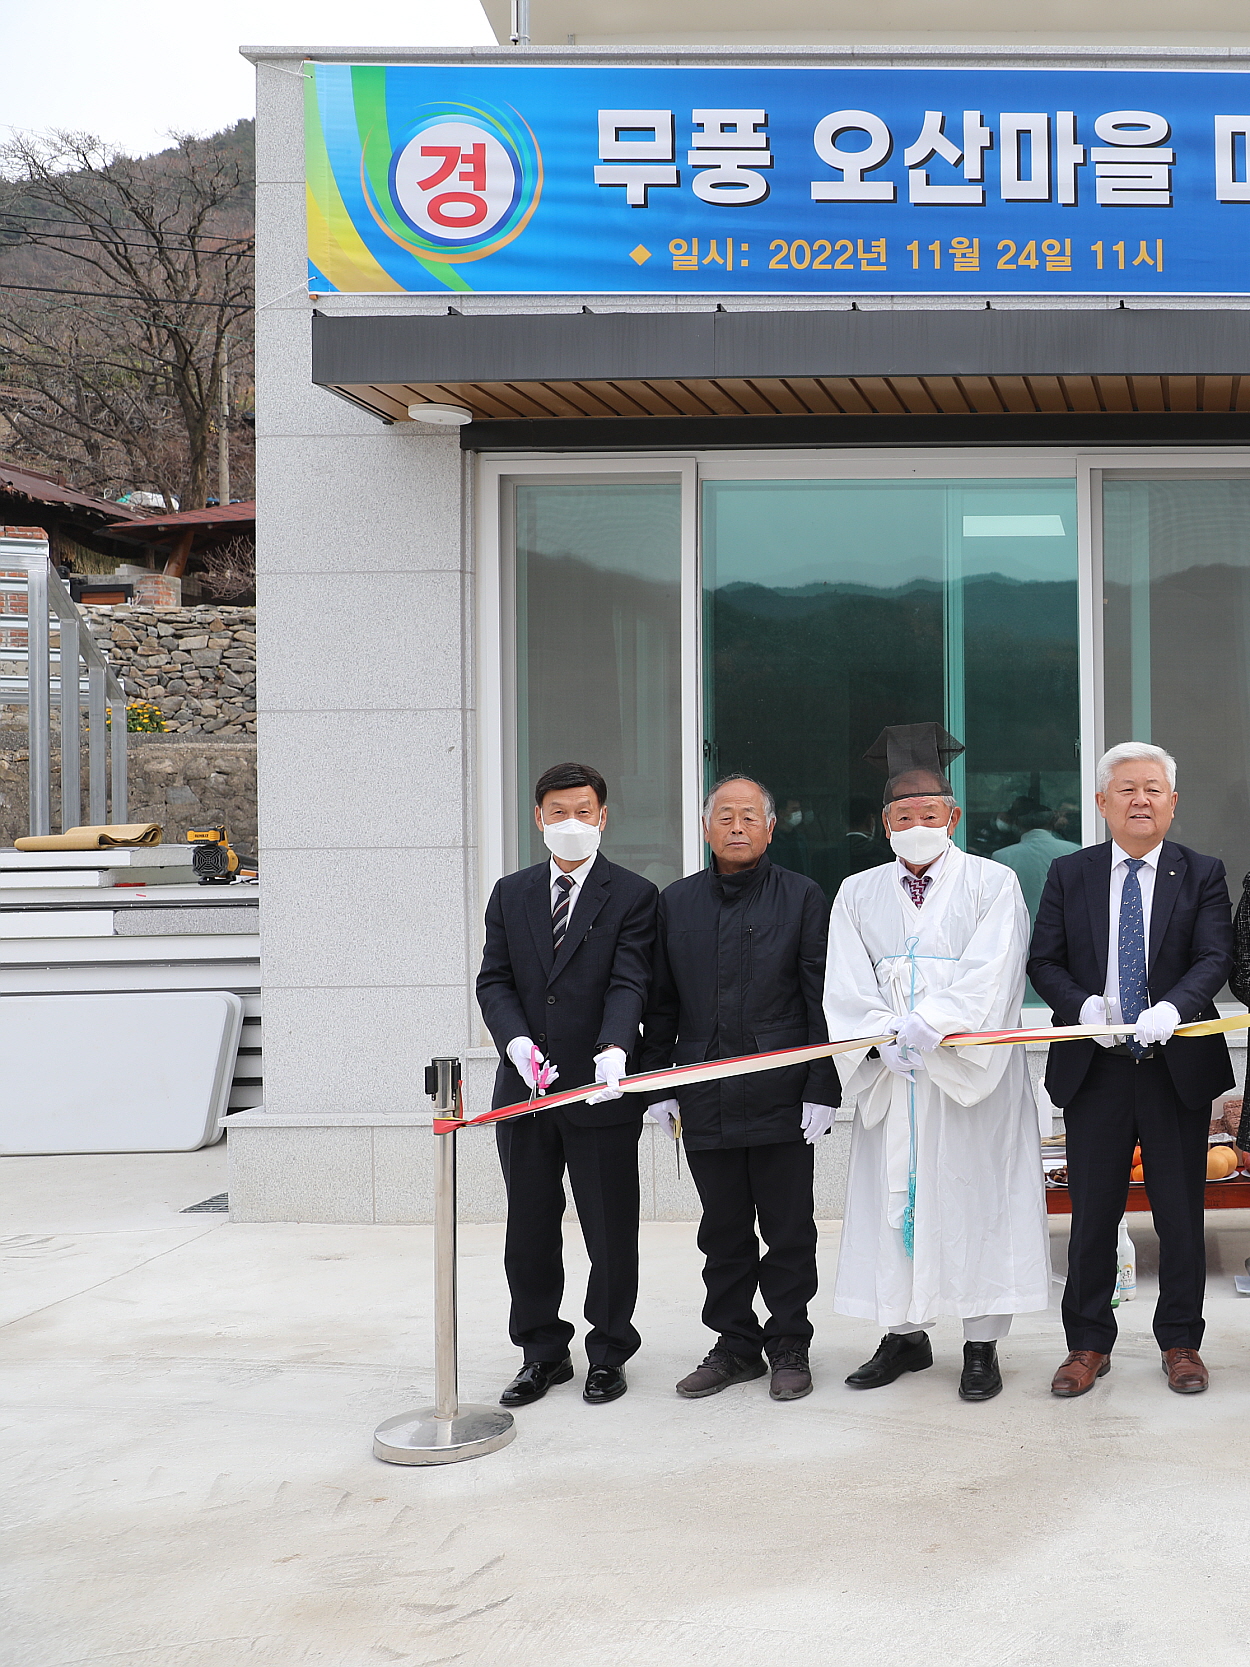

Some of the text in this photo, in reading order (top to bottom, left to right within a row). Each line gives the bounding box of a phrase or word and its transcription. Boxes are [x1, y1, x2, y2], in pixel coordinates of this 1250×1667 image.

[417, 143, 487, 228] 경
[594, 109, 773, 207] 무풍
[811, 110, 1174, 207] 오산마을
[669, 237, 1163, 272] 일시: 2022년 11월 24일 11시
